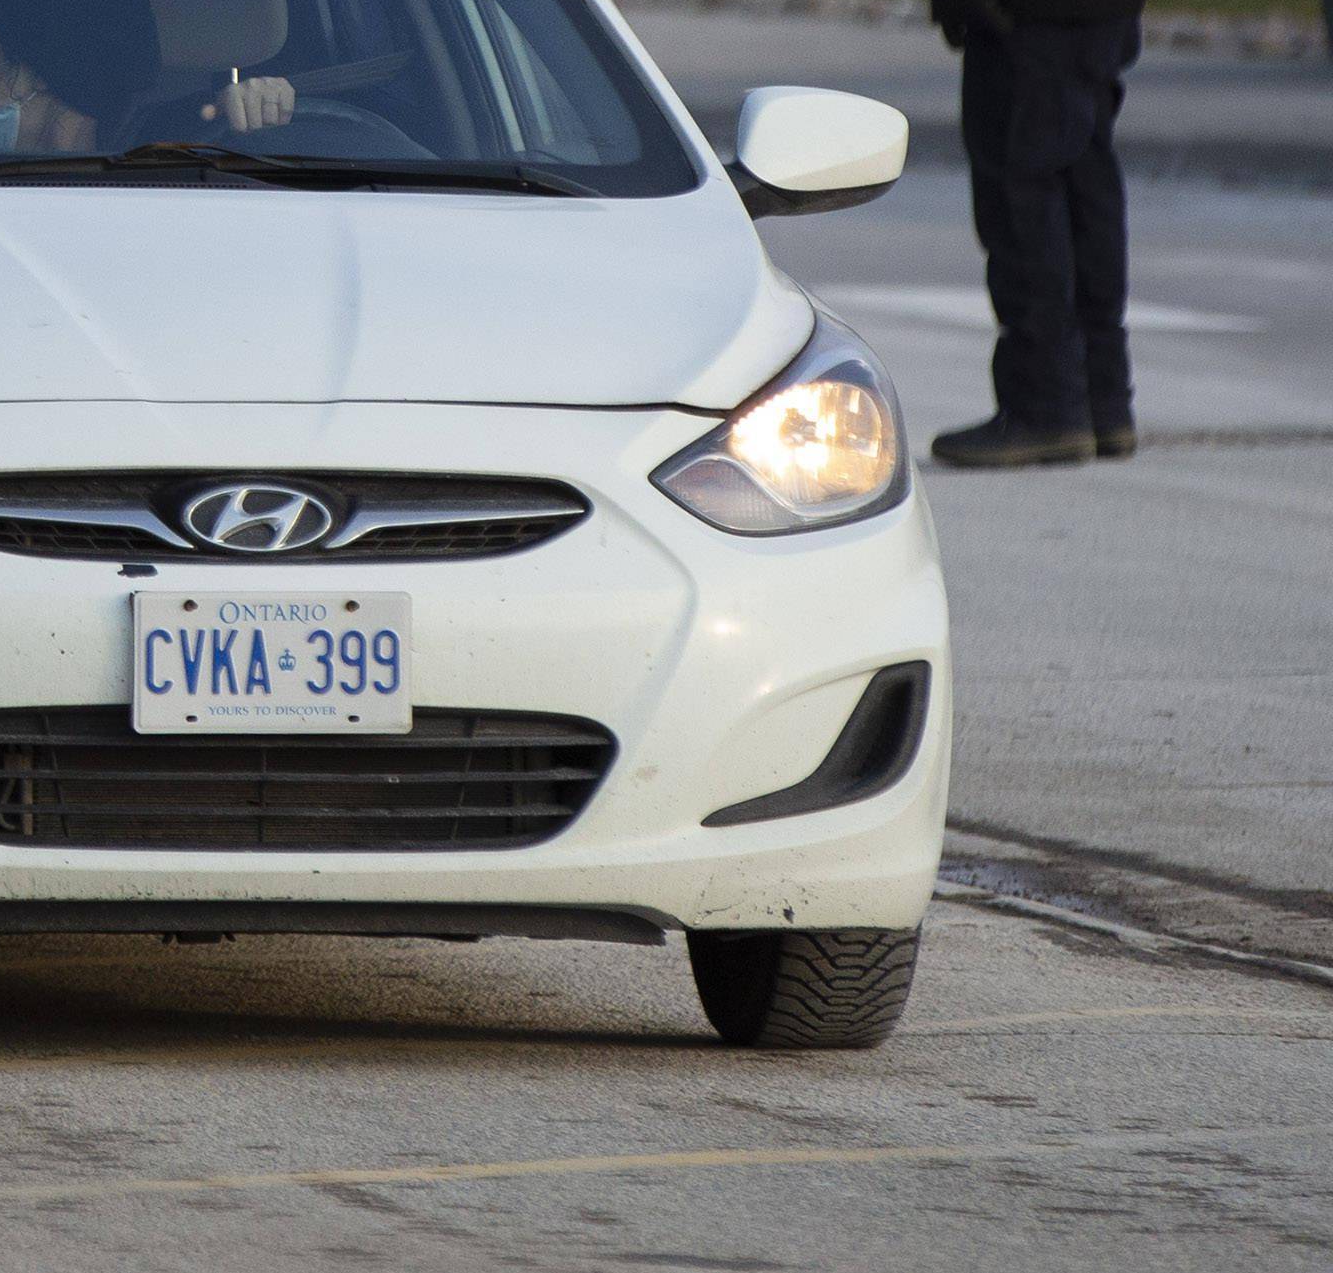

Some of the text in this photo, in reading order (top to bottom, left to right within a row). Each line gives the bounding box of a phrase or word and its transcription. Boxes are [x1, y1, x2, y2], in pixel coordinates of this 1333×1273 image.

[219, 600, 327, 625] ONTARIO
[145, 628, 401, 696] CVKA 399
[208, 705, 337, 717] YOURS TO DISCOVER
